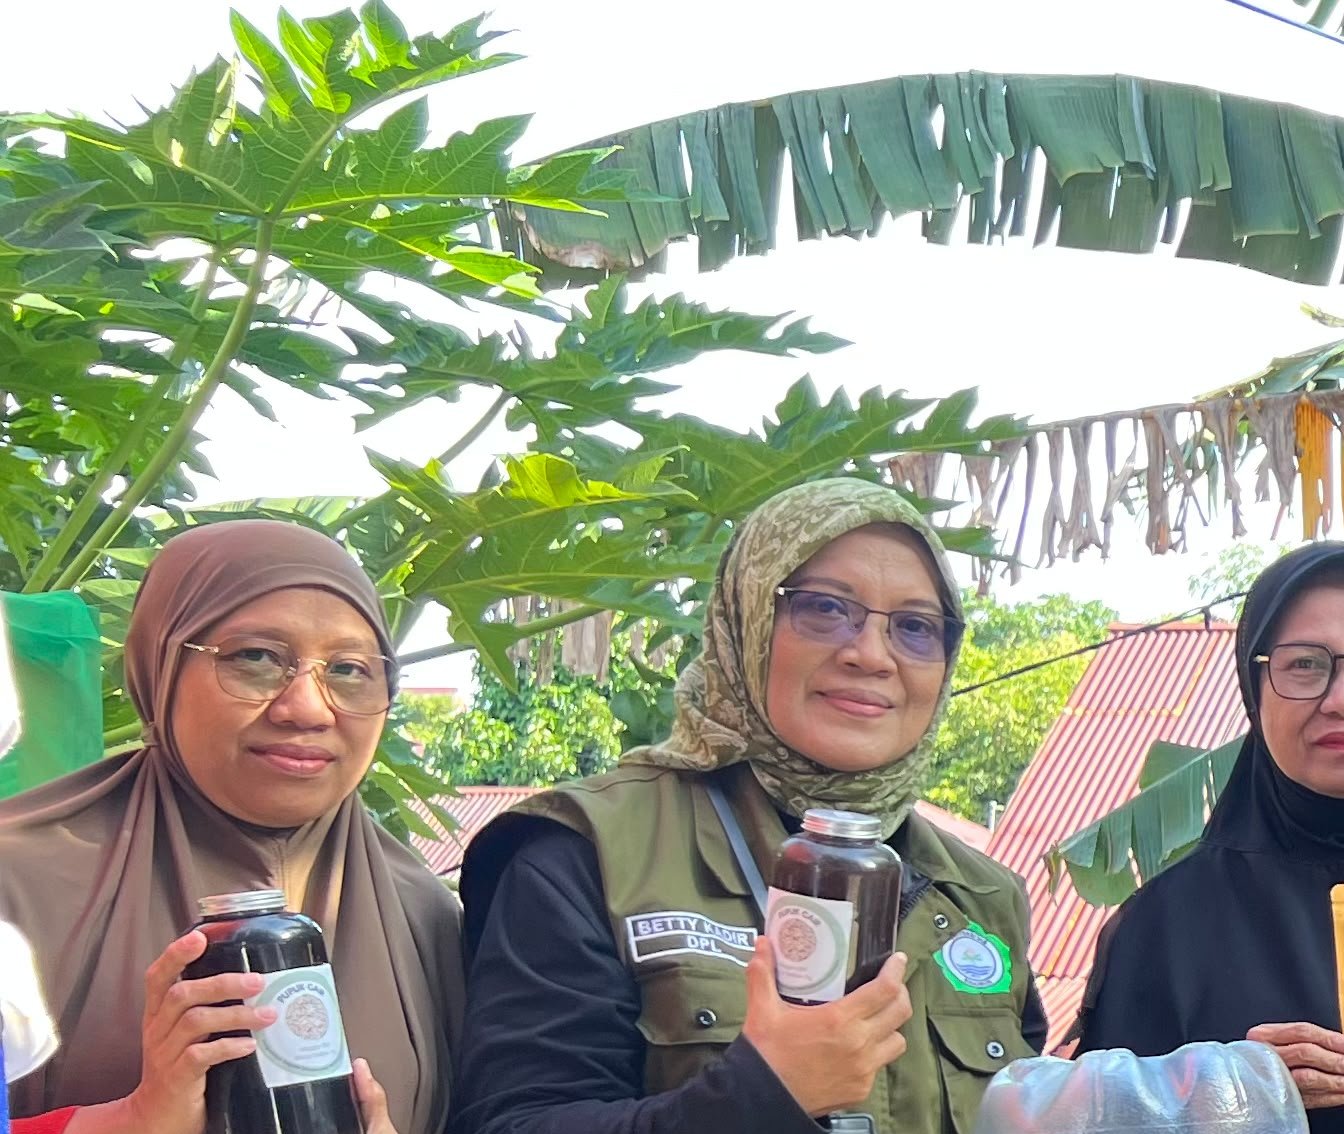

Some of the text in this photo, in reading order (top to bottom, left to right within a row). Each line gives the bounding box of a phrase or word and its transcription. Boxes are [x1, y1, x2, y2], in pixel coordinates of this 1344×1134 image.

[637, 918, 749, 946] BETTY KADIR
[687, 935, 722, 953] DPL
